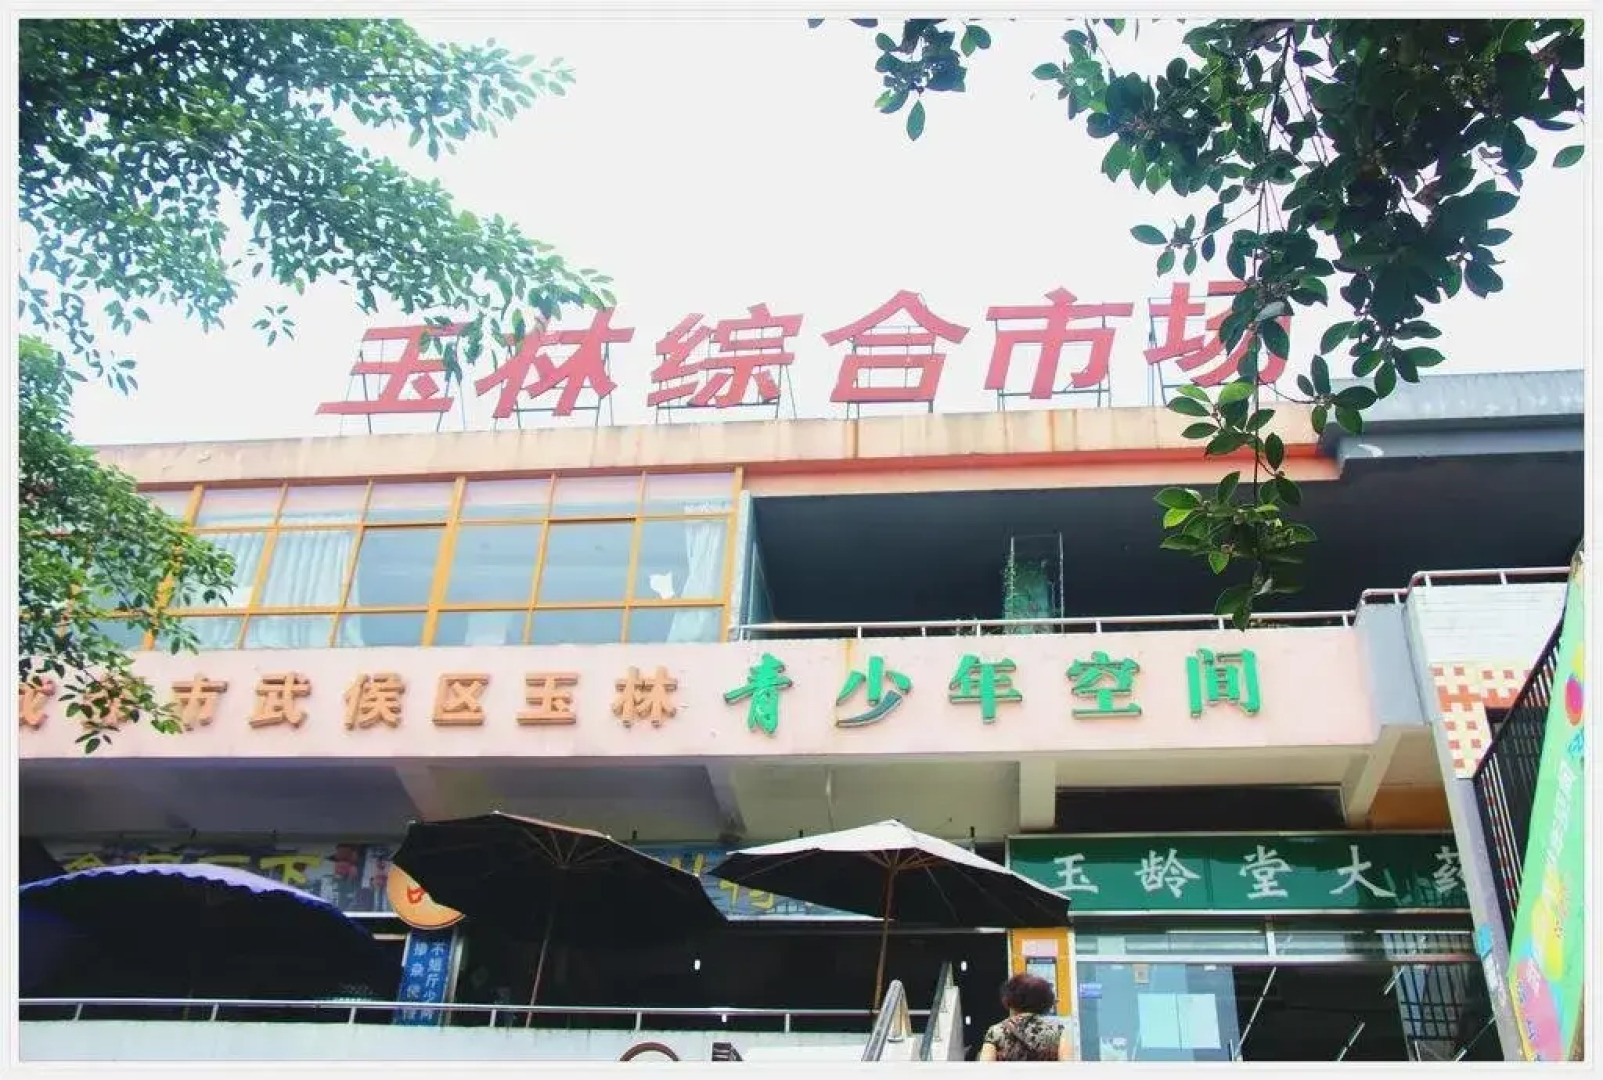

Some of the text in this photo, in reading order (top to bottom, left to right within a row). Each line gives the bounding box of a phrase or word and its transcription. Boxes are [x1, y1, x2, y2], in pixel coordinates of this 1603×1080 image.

[316, 281, 1291, 418] 玉林综合市场
[723, 647, 1261, 737] 青少年空间
